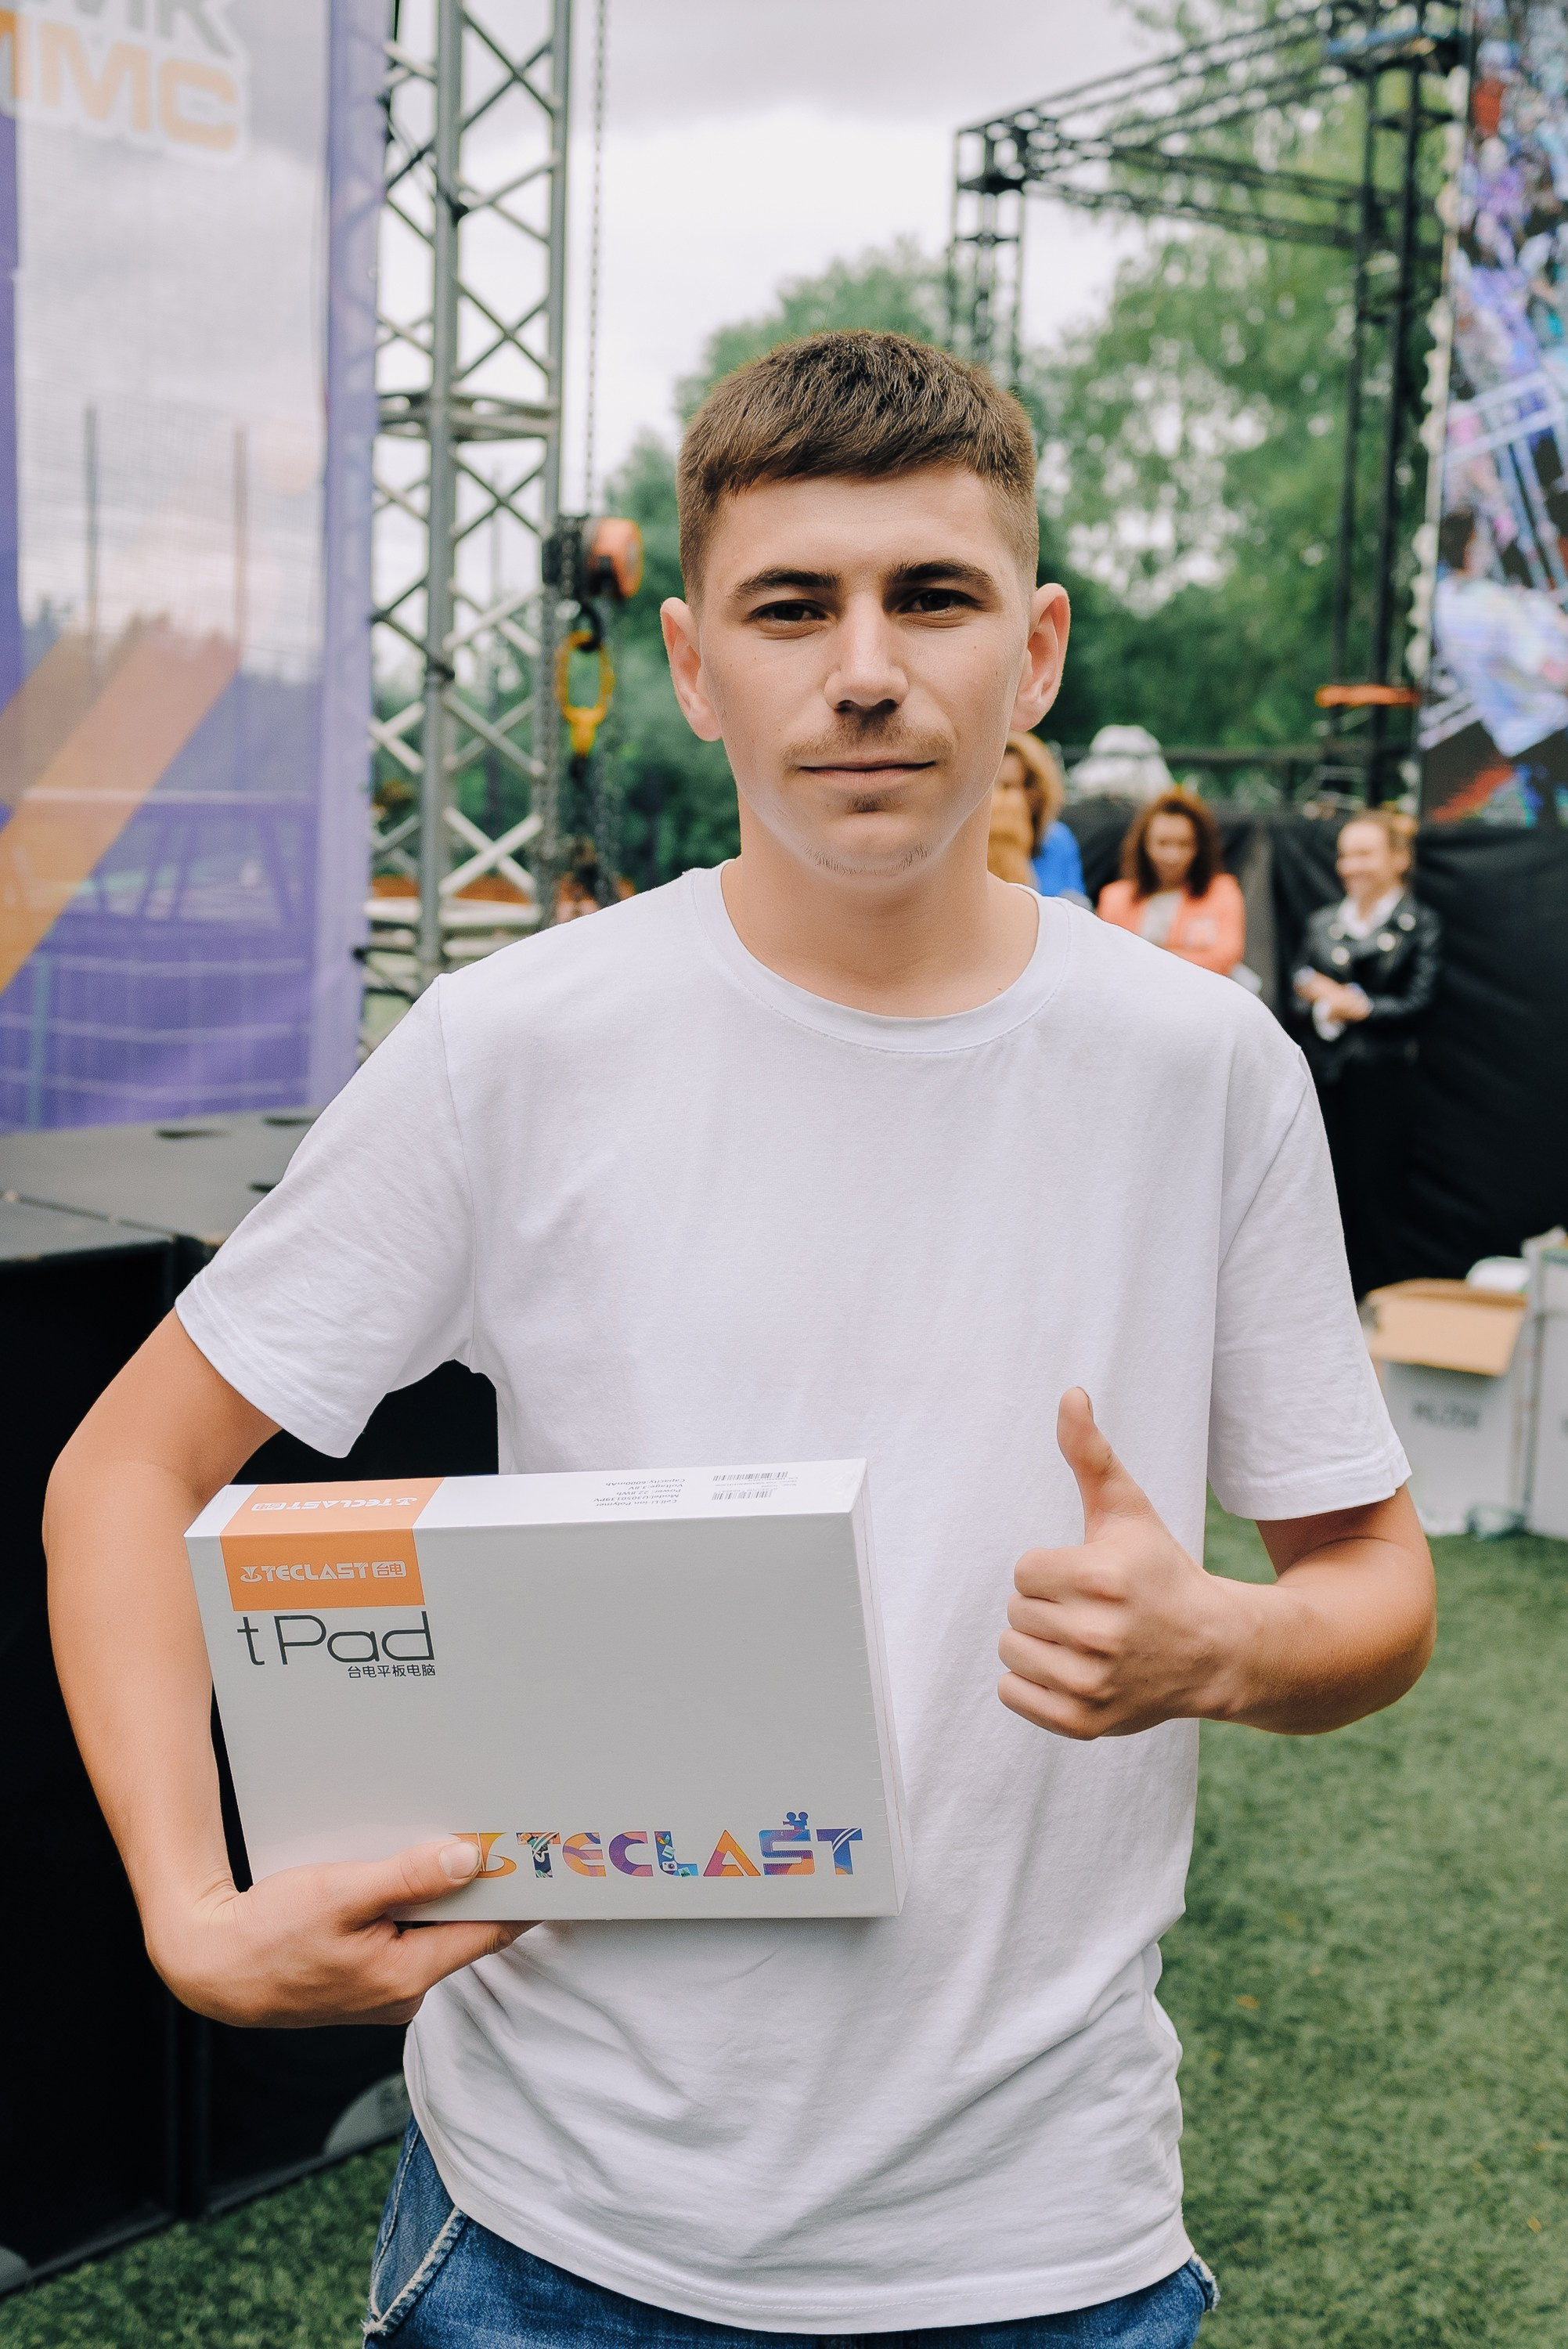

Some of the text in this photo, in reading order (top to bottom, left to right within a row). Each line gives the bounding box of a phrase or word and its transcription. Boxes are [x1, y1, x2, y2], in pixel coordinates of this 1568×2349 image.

[287, 1498, 391, 1510] TECLAST
[261, 1561, 406, 1582] TECLAST 台电
[348, 1663, 436, 1679] 台电平板电脑
[516, 1829, 863, 1878] TECLAST
